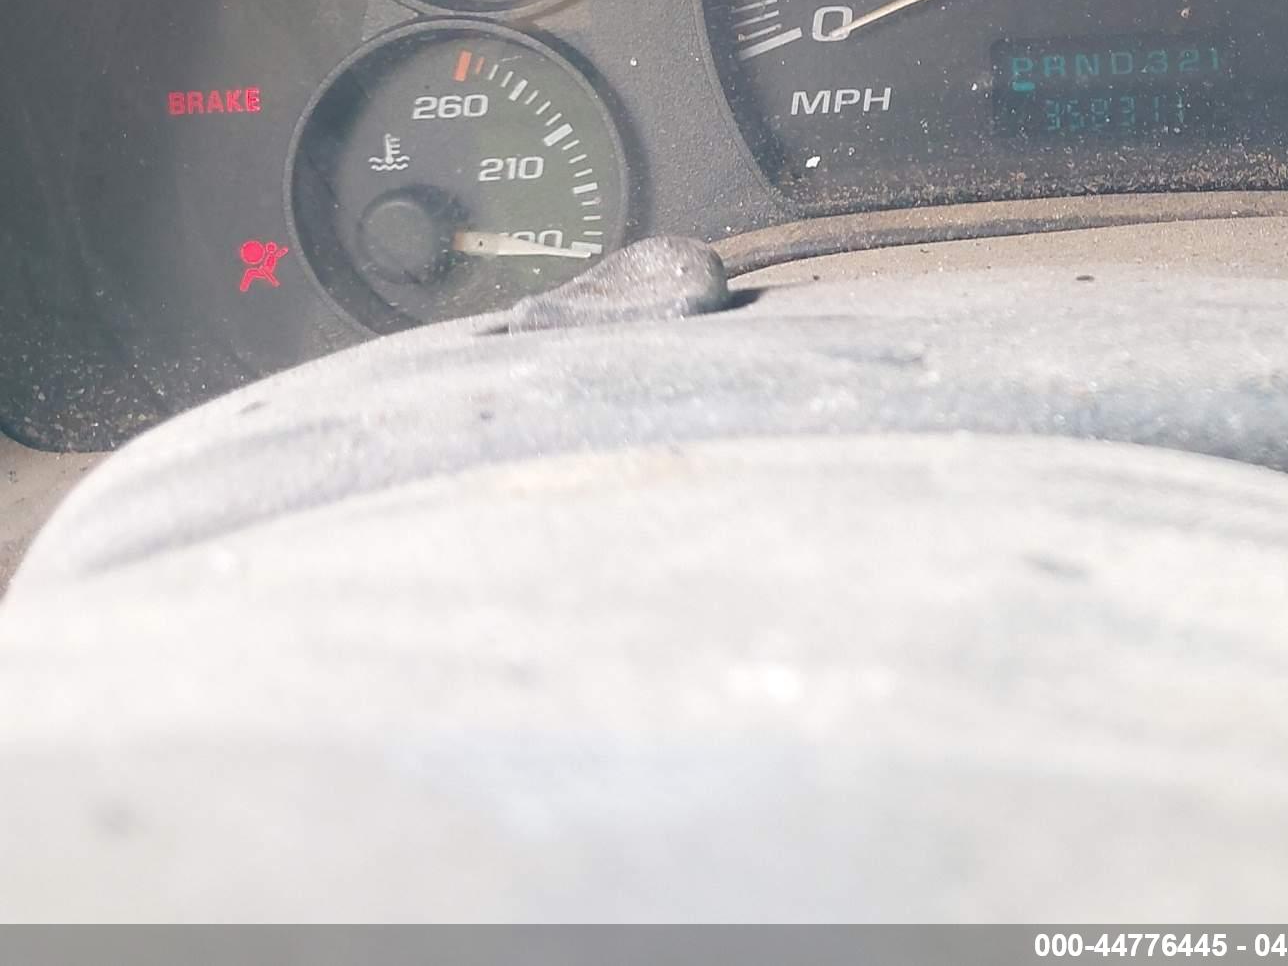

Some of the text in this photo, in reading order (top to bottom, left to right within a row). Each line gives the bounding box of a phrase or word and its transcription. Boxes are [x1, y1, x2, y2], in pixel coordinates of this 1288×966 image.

[811, 6, 853, 42] 0
[167, 87, 262, 116] BRAKE
[413, 94, 490, 120] 260
[790, 87, 893, 116] MPH
[478, 156, 545, 182] 210
